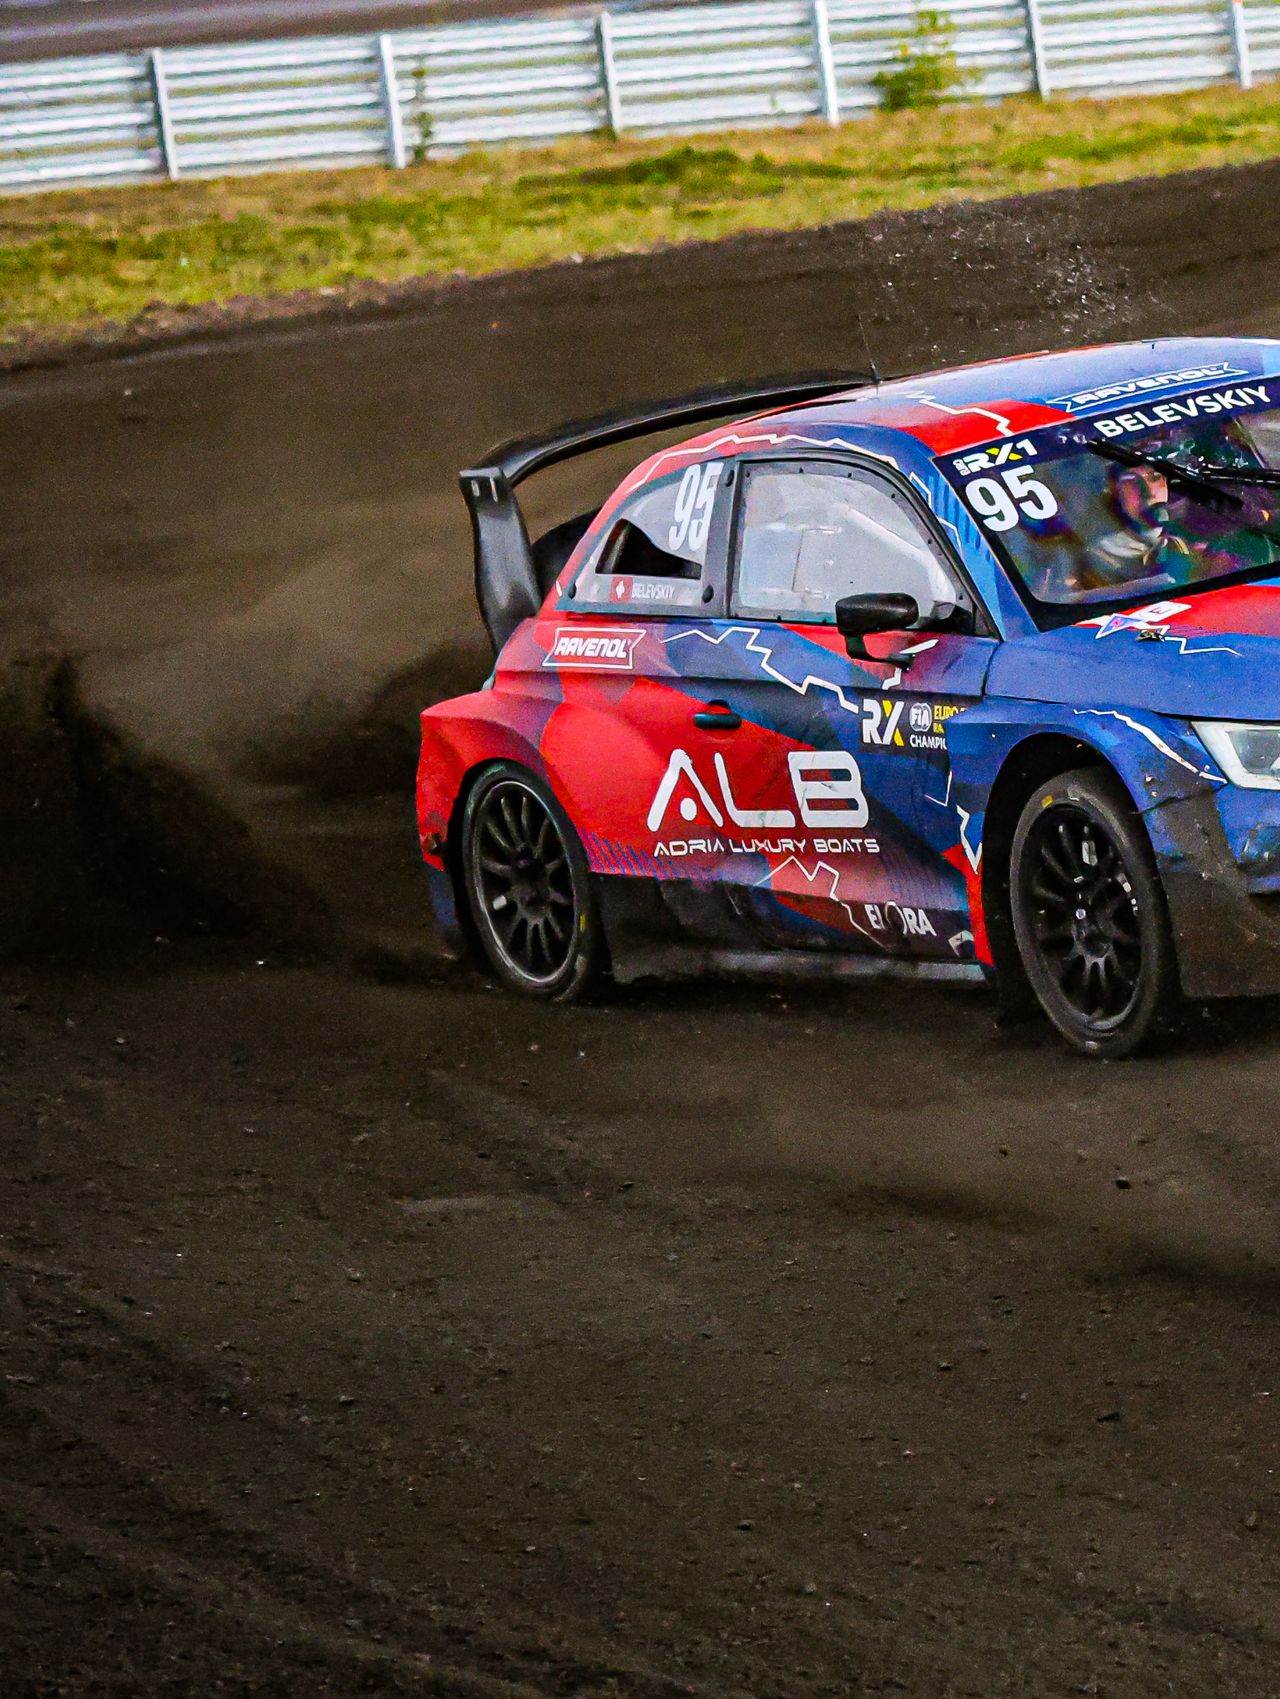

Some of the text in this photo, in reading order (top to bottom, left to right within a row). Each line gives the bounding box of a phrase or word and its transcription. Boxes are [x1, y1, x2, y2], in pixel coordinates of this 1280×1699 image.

[1070, 367, 1222, 405] RAVENOL
[1093, 385, 1272, 439] BELEVSKIY
[964, 439, 1038, 474] RX1
[669, 462, 724, 551] 95
[965, 465, 1058, 531] 95
[555, 636, 630, 659] RAVENOL
[862, 698, 905, 747] RX
[646, 748, 869, 832] ALB
[654, 838, 881, 857] ADRIA LUXURY BOATS
